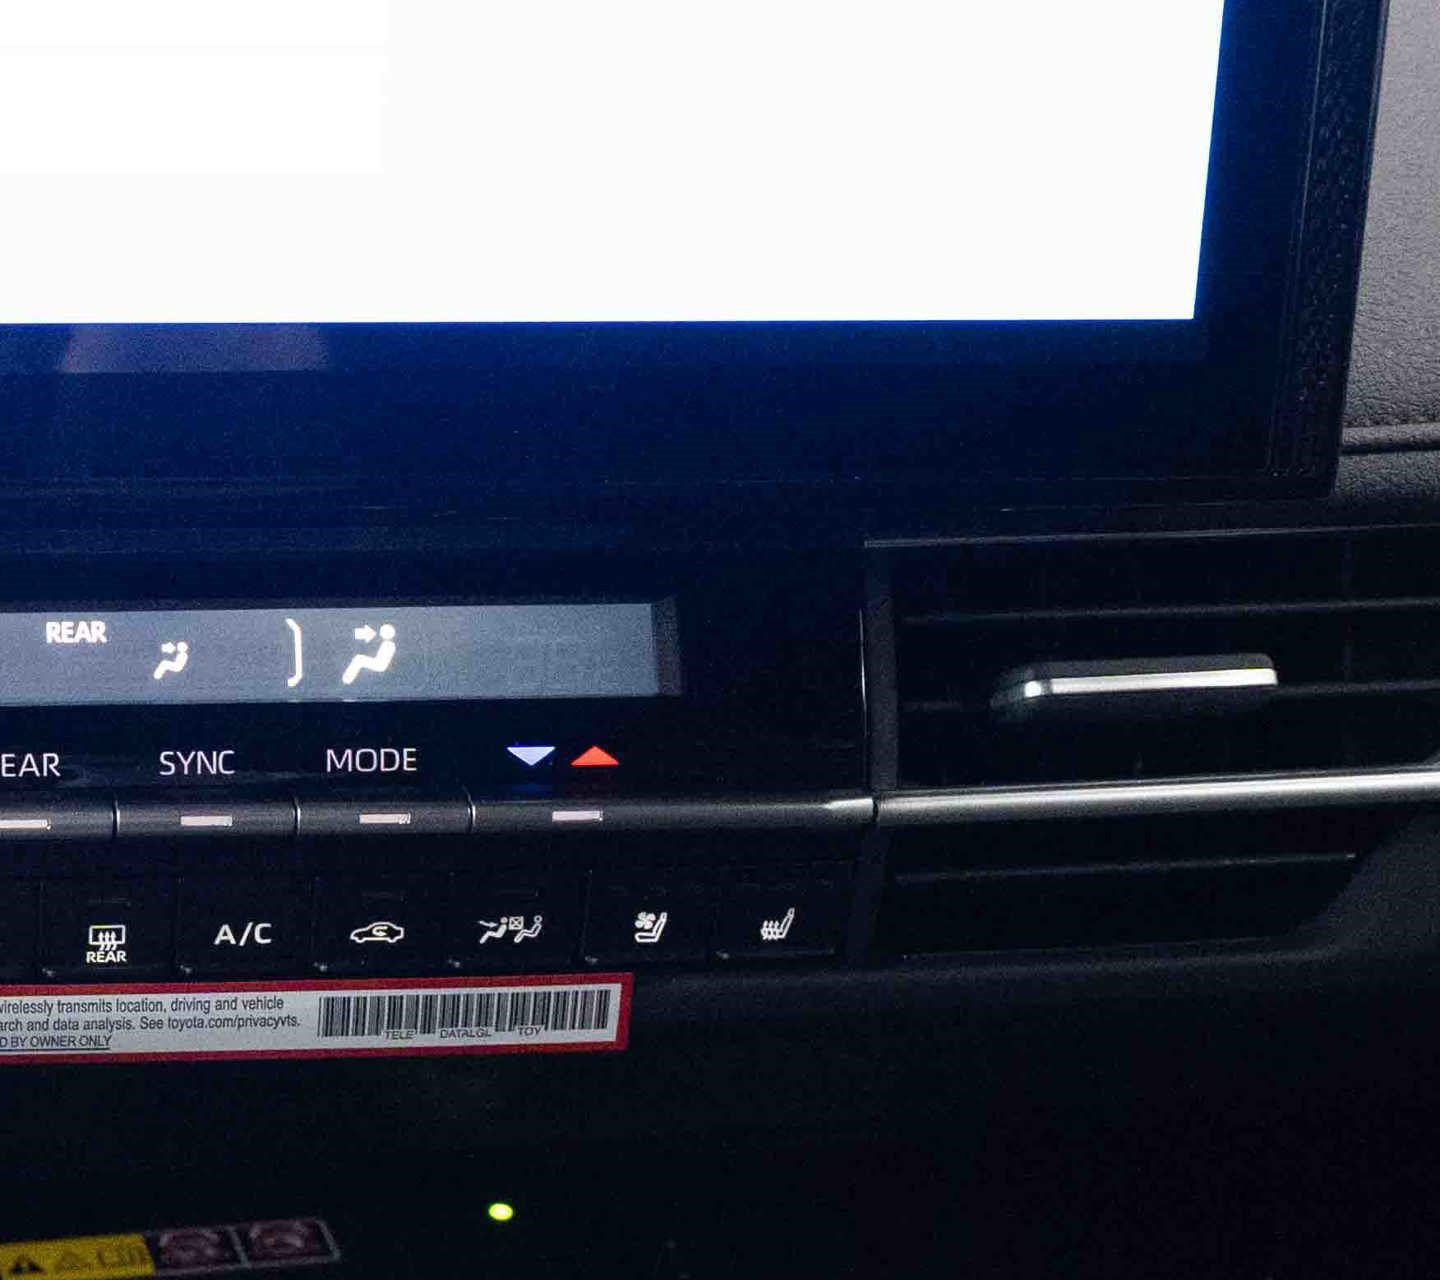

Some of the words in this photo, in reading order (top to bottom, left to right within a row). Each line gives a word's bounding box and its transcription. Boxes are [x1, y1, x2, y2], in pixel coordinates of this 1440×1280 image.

[45, 621, 108, 646] REAR
[158, 747, 236, 778] SYNC
[325, 745, 418, 774] MODE
[214, 920, 273, 948] A/C
[85, 948, 128, 965] REAR
[57, 999, 112, 1013] transmits
[116, 998, 166, 1013] location,
[170, 997, 210, 1014] driving
[214, 997, 238, 1011] and
[241, 995, 284, 1010] vehicle
[26, 1018, 49, 1031] and
[52, 1018, 79, 1031] data
[83, 1017, 136, 1034] analysis.
[140, 1017, 164, 1030] See
[10, 1036, 26, 1048] BY
[29, 1035, 76, 1048] OWNER
[79, 1035, 112, 1048] ONLY
